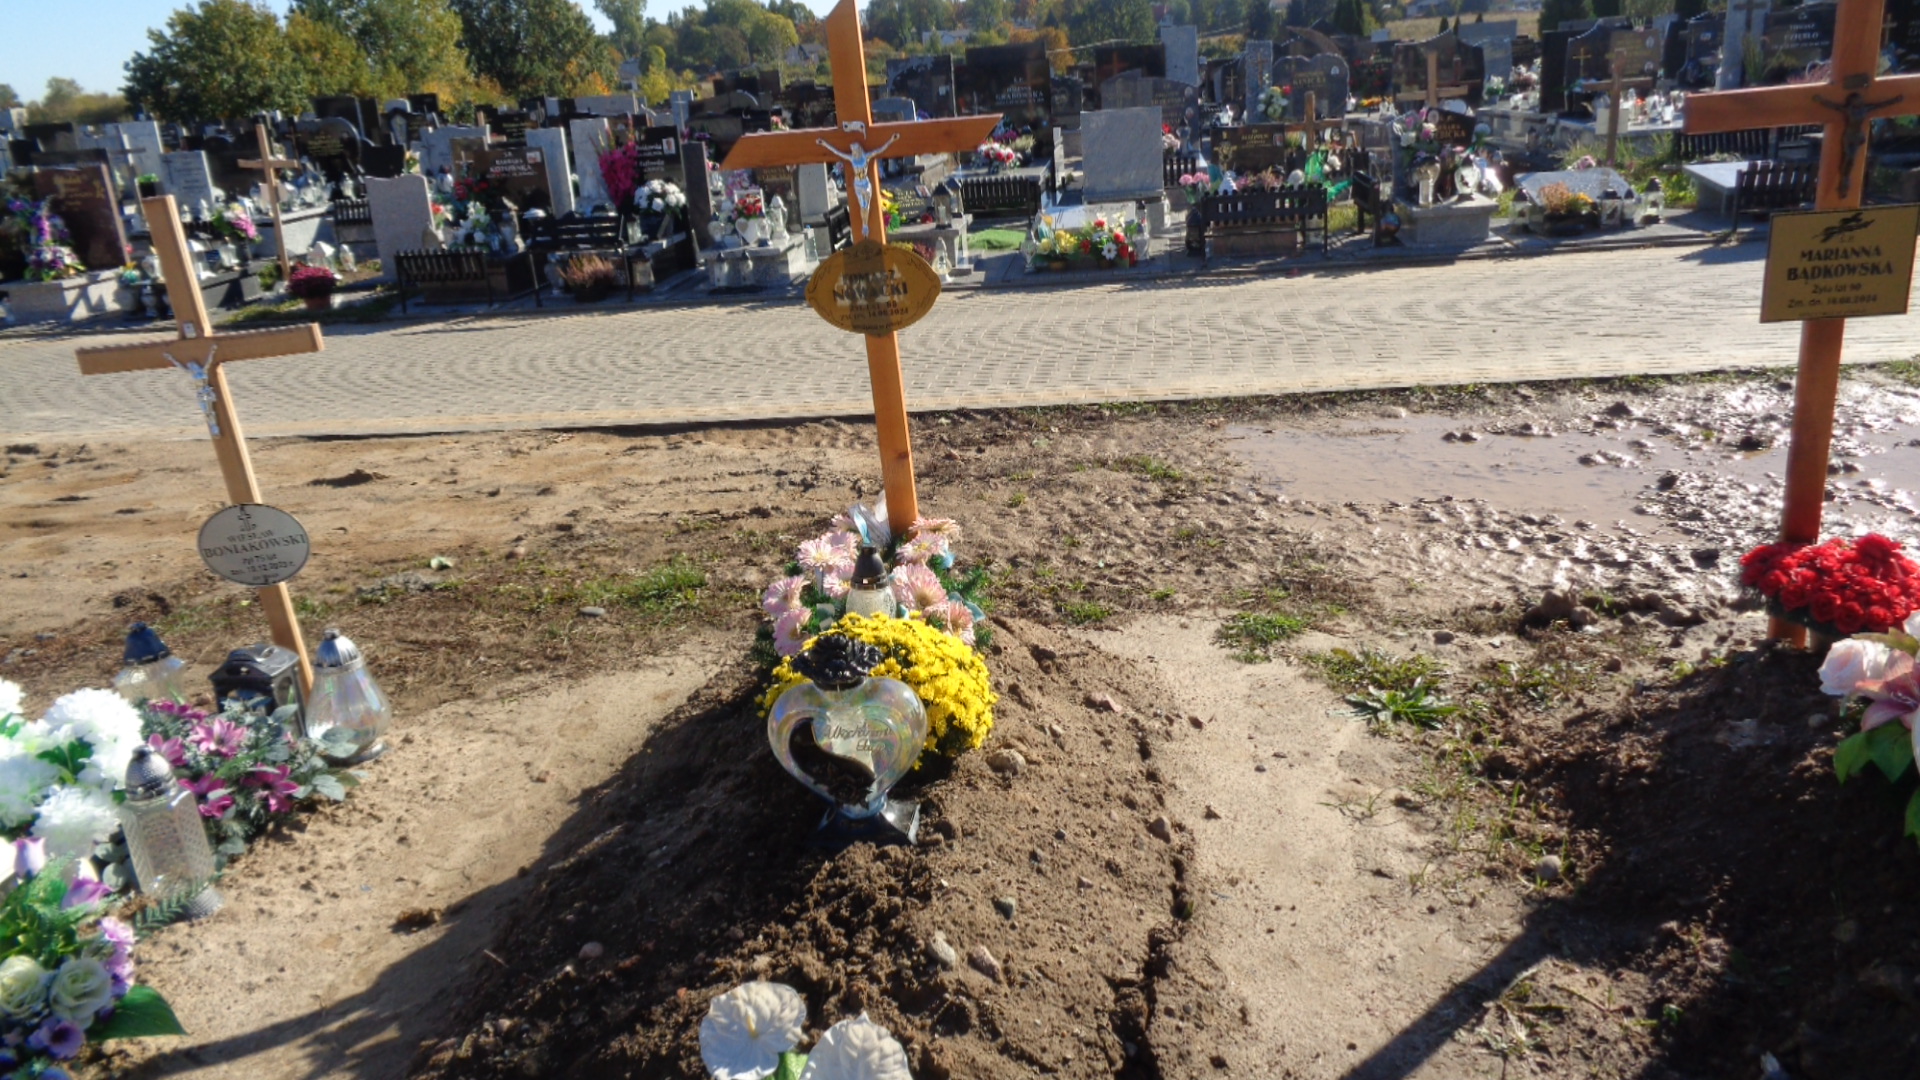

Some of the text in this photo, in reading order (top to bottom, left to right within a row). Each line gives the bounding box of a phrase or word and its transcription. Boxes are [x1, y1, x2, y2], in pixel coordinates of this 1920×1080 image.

[1800, 244, 1882, 262] MARIANNA
[1787, 260, 1893, 285] BĄDKOWSKA
[833, 281, 908, 302] NOWACKI
[203, 534, 307, 558] BONIAKOWSKI
[227, 529, 274, 543] WIESŁAW
